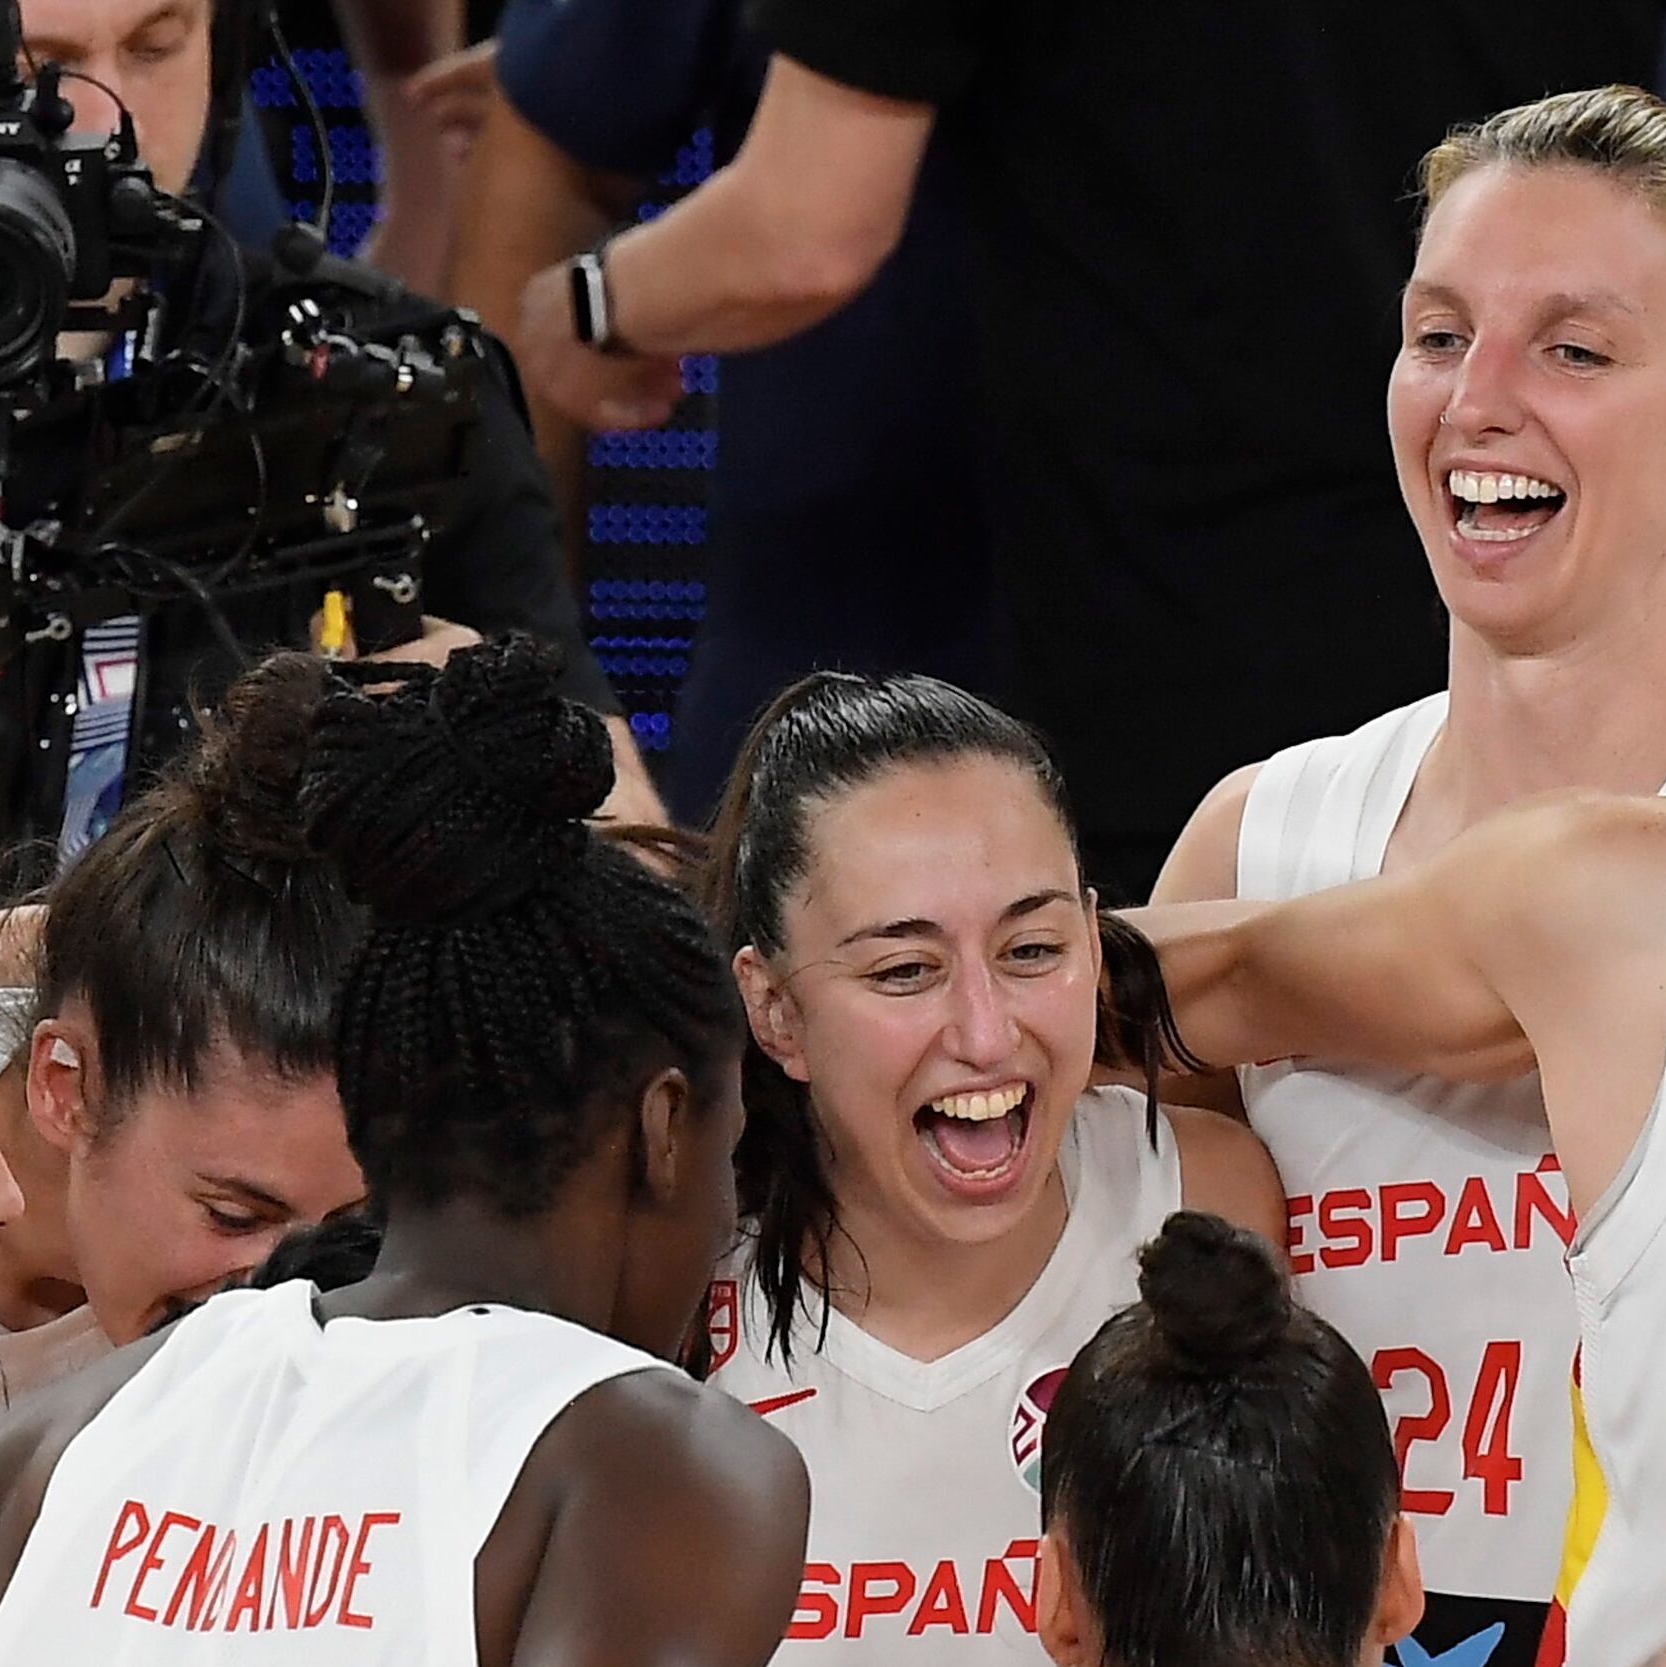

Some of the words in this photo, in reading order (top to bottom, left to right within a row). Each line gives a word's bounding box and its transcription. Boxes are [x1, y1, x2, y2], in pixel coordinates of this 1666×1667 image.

[1286, 1152, 1578, 1276] ESPAÑ
[1371, 1340, 1523, 1517] 24
[781, 1538, 1042, 1641] SPAÑ
